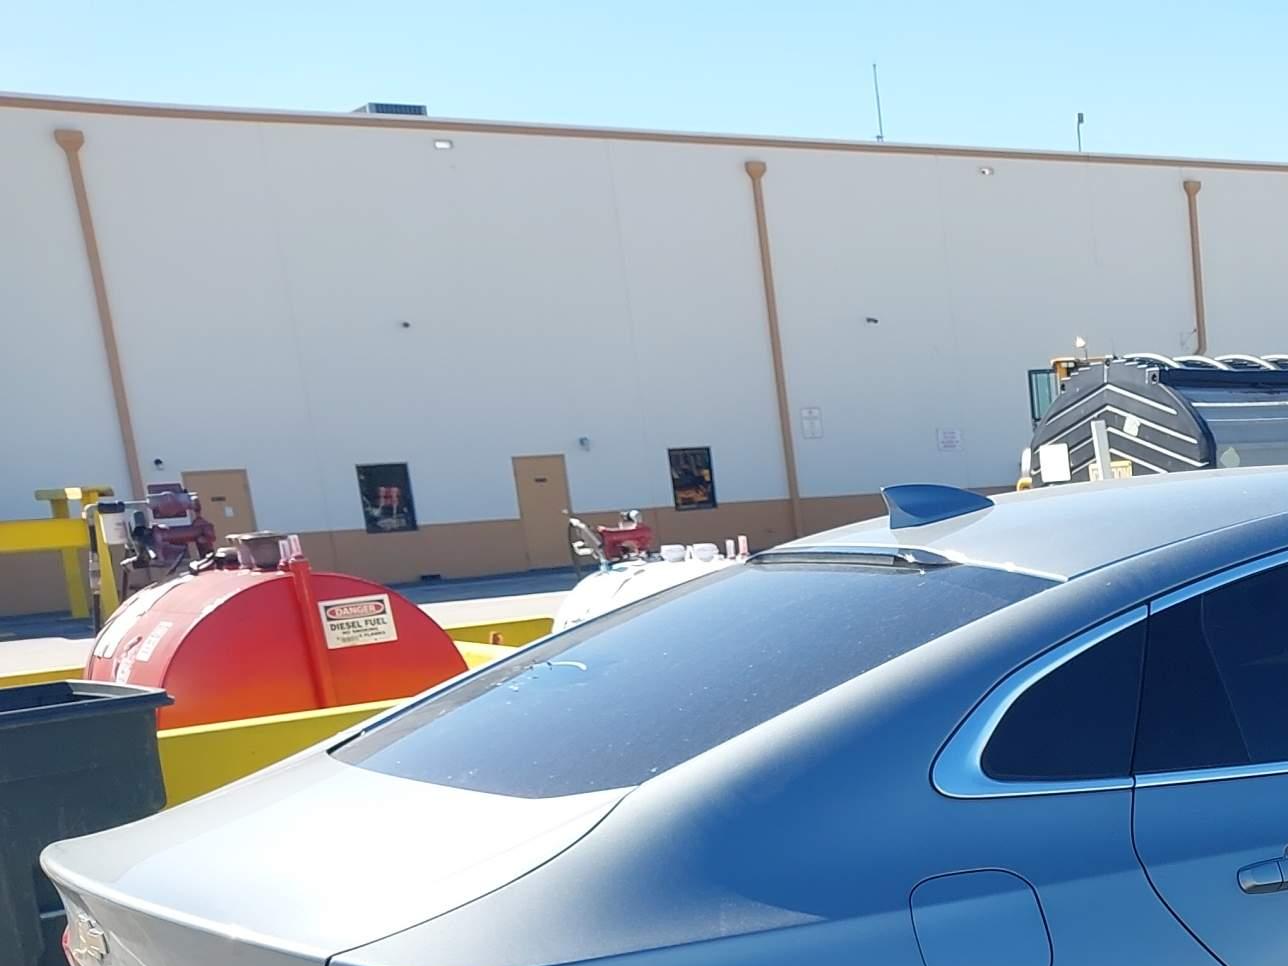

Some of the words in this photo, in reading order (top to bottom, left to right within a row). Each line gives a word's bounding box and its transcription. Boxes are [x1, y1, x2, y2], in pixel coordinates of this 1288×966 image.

[335, 604, 376, 617] DANGER
[330, 620, 362, 631] DIESEL
[364, 617, 388, 627] FUEL
